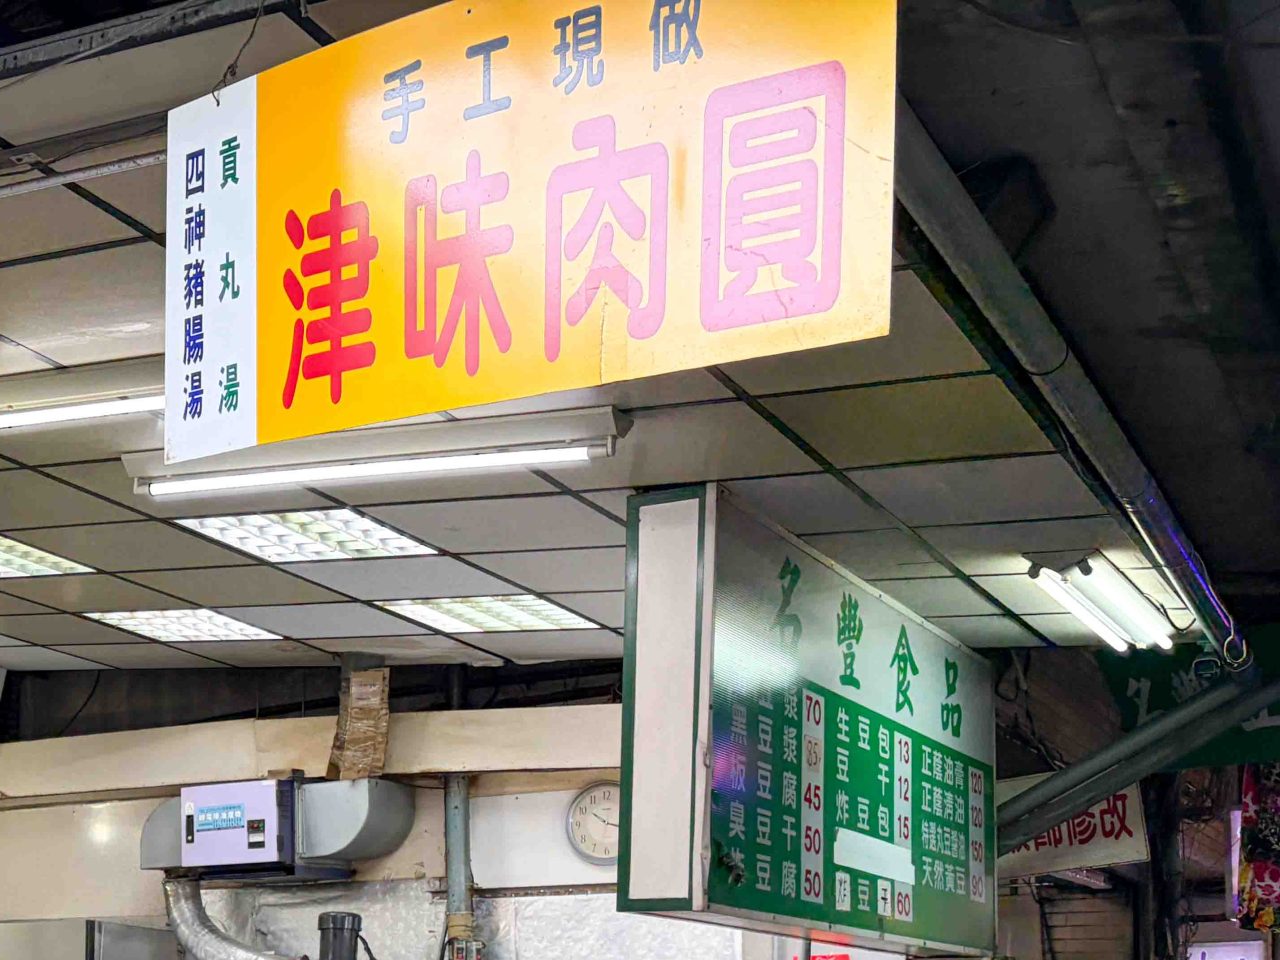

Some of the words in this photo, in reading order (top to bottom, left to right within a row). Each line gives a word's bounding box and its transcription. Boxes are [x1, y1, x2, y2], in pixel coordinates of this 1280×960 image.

[381, 0, 703, 145] 手工現做
[282, 60, 846, 410] 津味肉圓
[182, 148, 206, 422] 四神豬腸湯
[217, 135, 241, 415] 貢丸湯
[772, 555, 963, 738] 名豐食品
[805, 694, 821, 726] 70
[836, 706, 890, 759] 生豆包
[897, 738, 910, 764] 13
[804, 781, 821, 811] 45
[836, 747, 890, 796] 豆干
[897, 776, 910, 801] 12
[970, 771, 983, 795] 120
[728, 800, 797, 852] 臭豆干
[804, 828, 821, 855] 50
[836, 789, 890, 837] 炸豆包
[897, 814, 910, 840] 15
[970, 806, 983, 828] 120
[970, 840, 983, 863] 150
[804, 867, 821, 897] 50
[897, 891, 910, 916] 60
[971, 875, 984, 898] 90
